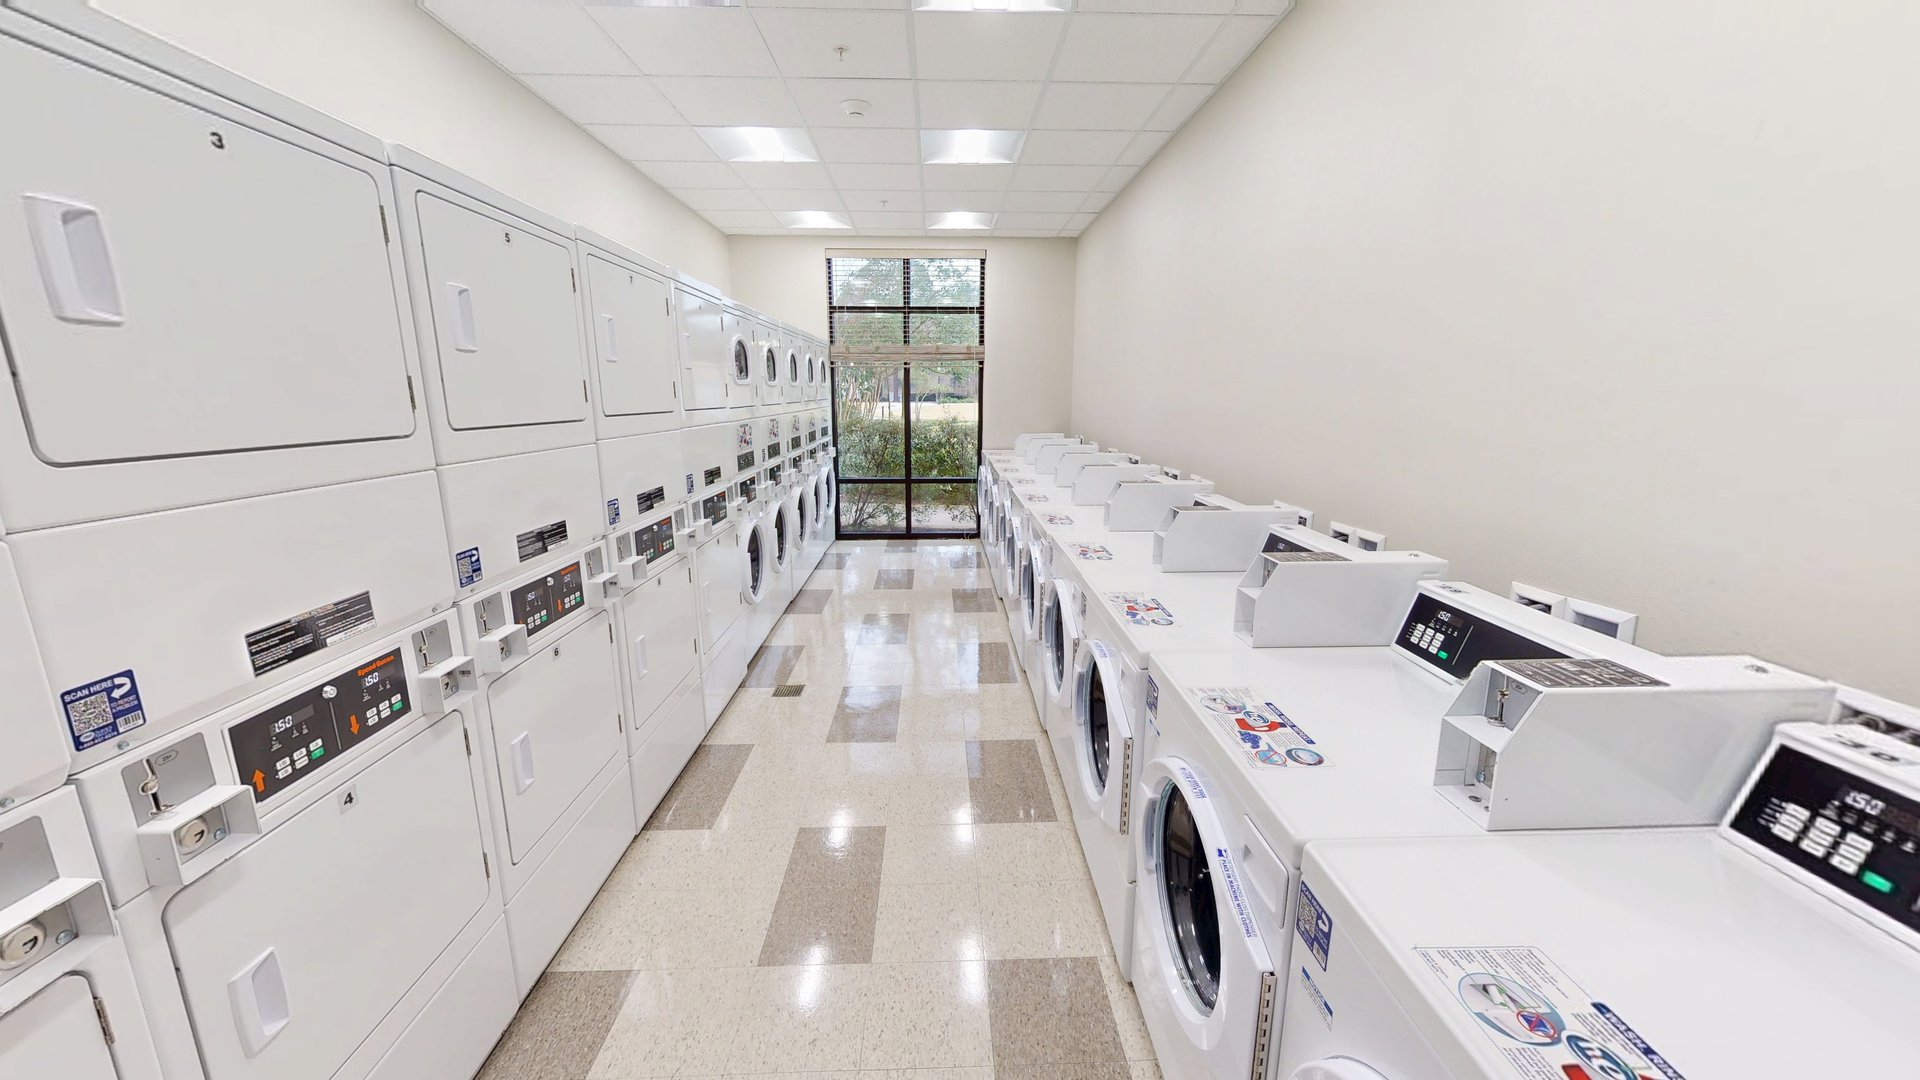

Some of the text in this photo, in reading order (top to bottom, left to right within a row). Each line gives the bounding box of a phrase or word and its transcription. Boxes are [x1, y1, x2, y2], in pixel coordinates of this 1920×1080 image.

[209, 131, 225, 149] 3
[504, 232, 511, 243] 5
[554, 647, 560, 657] 6
[64, 679, 114, 702] SCAN HERE
[343, 791, 354, 805] 4
[1222, 859, 1230, 873] PLACE
[1228, 879, 1239, 902] MACHINE
[1236, 902, 1244, 916] WITH
[1241, 916, 1253, 938] CLOTHES
